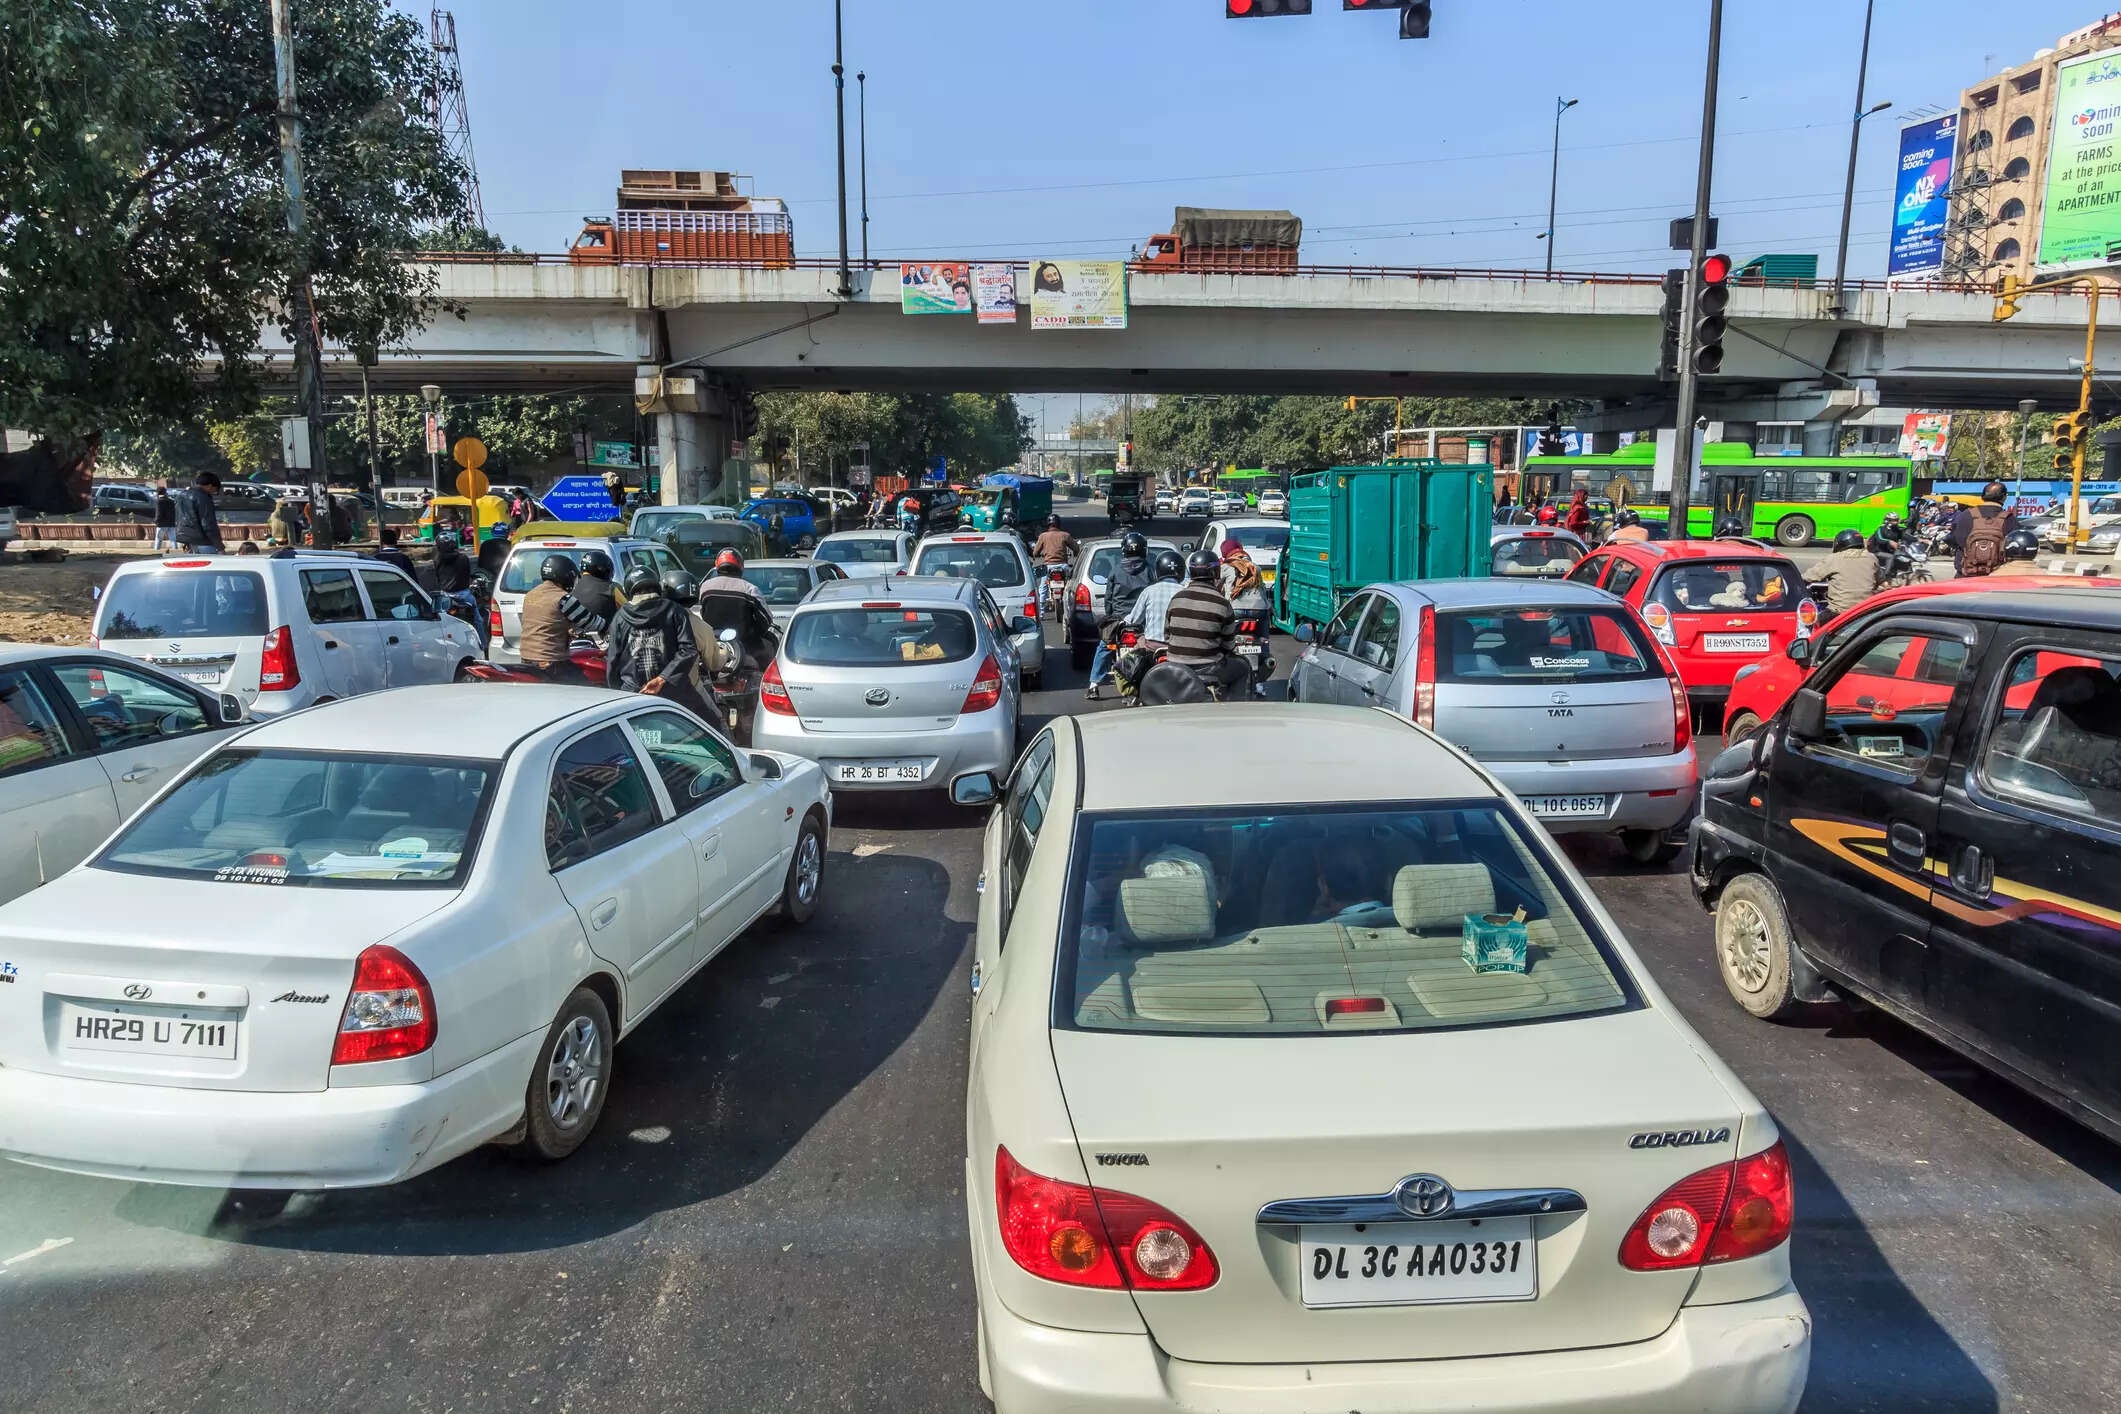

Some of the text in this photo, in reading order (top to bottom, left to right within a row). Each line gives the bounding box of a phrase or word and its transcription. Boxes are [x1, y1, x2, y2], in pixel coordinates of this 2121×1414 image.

[2071, 103, 2121, 126] comin
[2081, 122, 2113, 139] soon
[1903, 148, 1935, 163] coming
[2076, 145, 2113, 163] FARMS
[2062, 161, 2121, 181] at the price
[1916, 174, 1937, 190] NX
[2077, 180, 2104, 194] of an
[1904, 190, 1935, 207] ONE
[2017, 497, 2038, 505] DELHI
[196, 672, 216, 680] 2819
[1547, 709, 1574, 717] TATA
[841, 767, 919, 778] HR 26 BT 4352
[1524, 799, 1540, 813] DL
[1571, 797, 1604, 811] 0657
[232, 866, 290, 879] FX HYUNDAI
[1479, 964, 1526, 973] POP UP
[269, 989, 331, 1005] Accent
[75, 1015, 226, 1048] HR29 U 7111
[1628, 1127, 1731, 1150] COROLLA
[1095, 1152, 1150, 1166] TOYOTA
[1312, 1239, 1522, 1281] DL 3C AA0331
